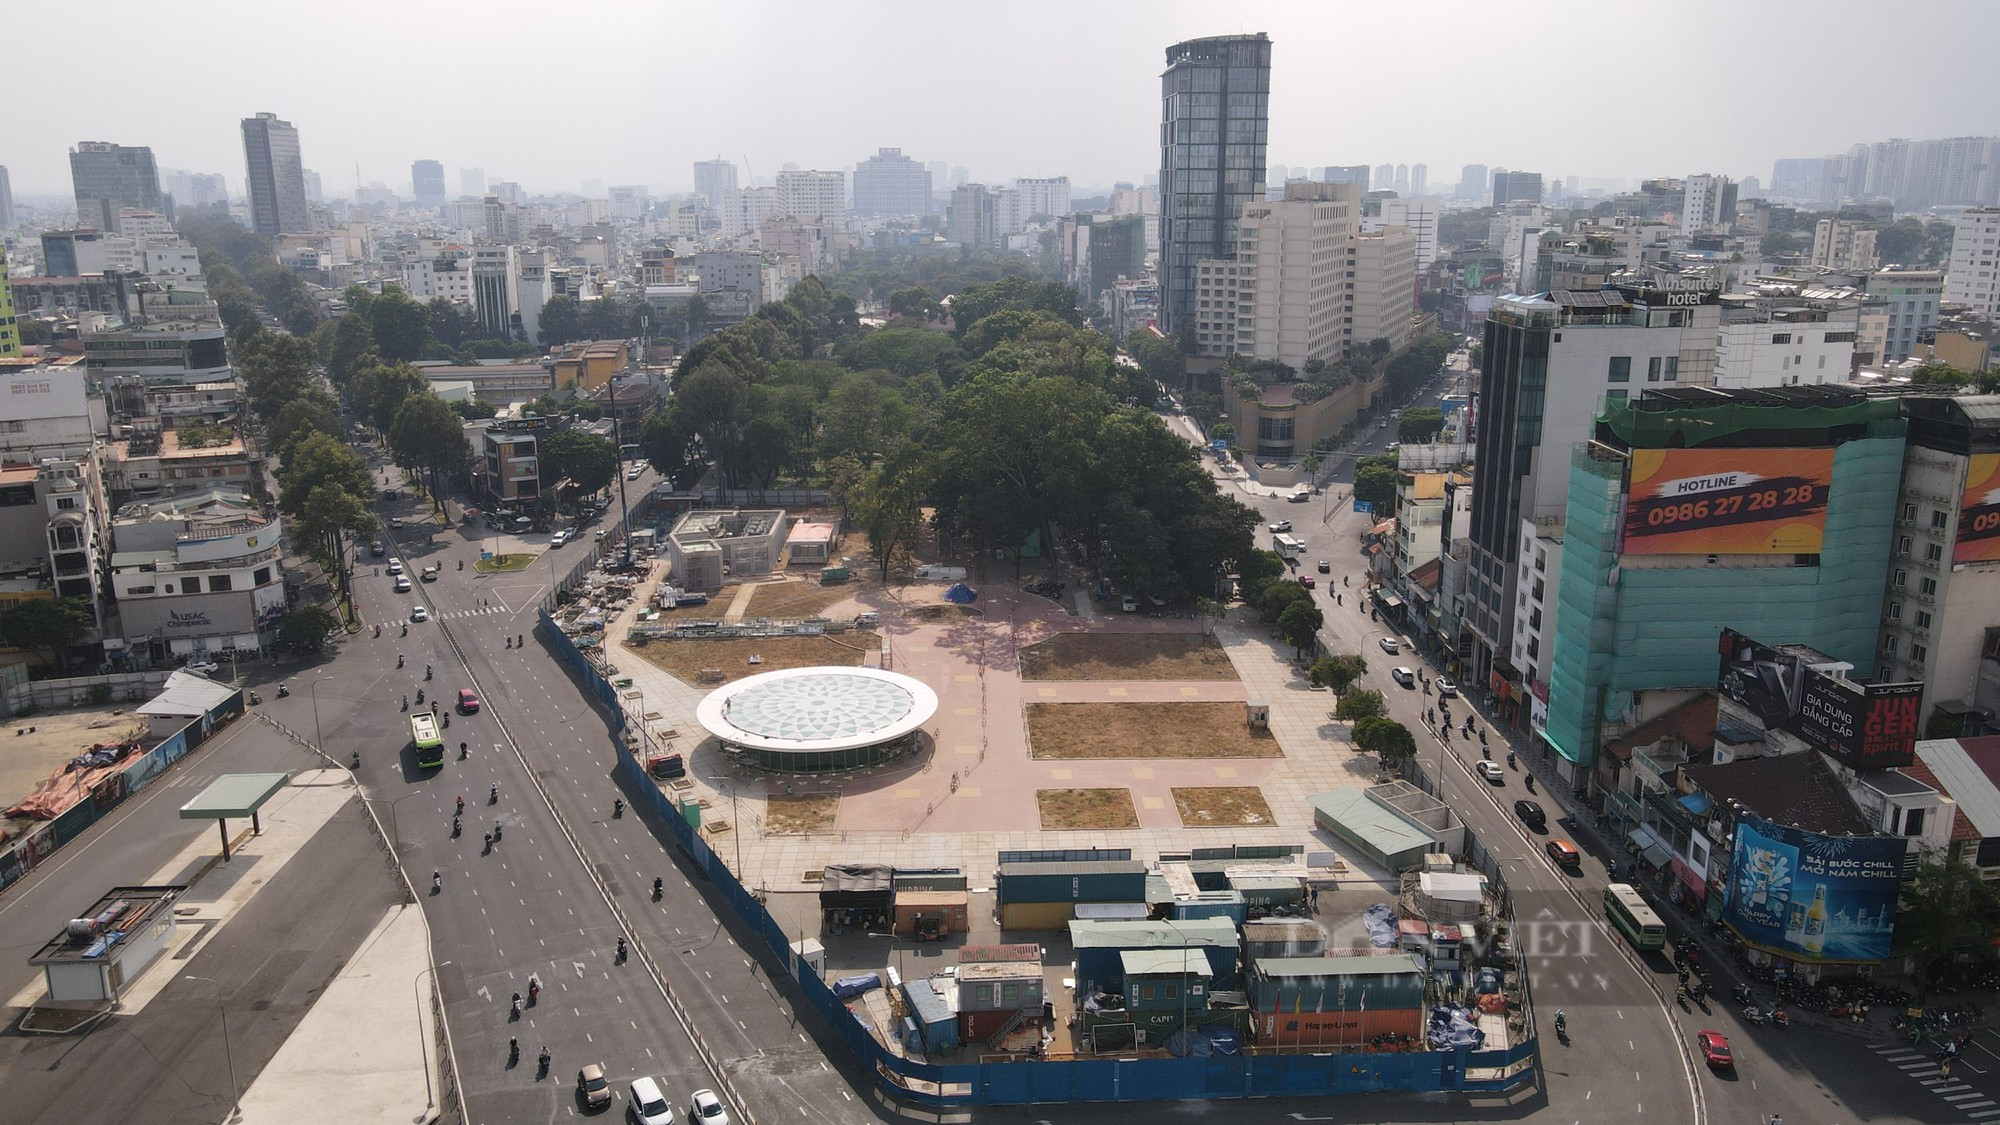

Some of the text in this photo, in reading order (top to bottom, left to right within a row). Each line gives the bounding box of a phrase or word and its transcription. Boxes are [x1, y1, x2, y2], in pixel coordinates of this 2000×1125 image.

[1666, 291, 1701, 305] hotel
[1677, 475, 1738, 493] HOTLINE
[1648, 485, 1813, 526] 0986 27 28 28
[167, 619, 212, 627] Chiropractic
[180, 612, 205, 620] USAC
[1806, 694, 1853, 725] GIA DỤNG
[1867, 697, 1917, 718] JUN
[1831, 721, 1853, 738] CẤP
[1864, 715, 1917, 736] GER
[1829, 858, 1860, 868] BƯỚC
[1861, 870, 1897, 878] CHILL
[1744, 906, 1772, 920] HAPPY
[1757, 917, 1781, 929] YEAR
